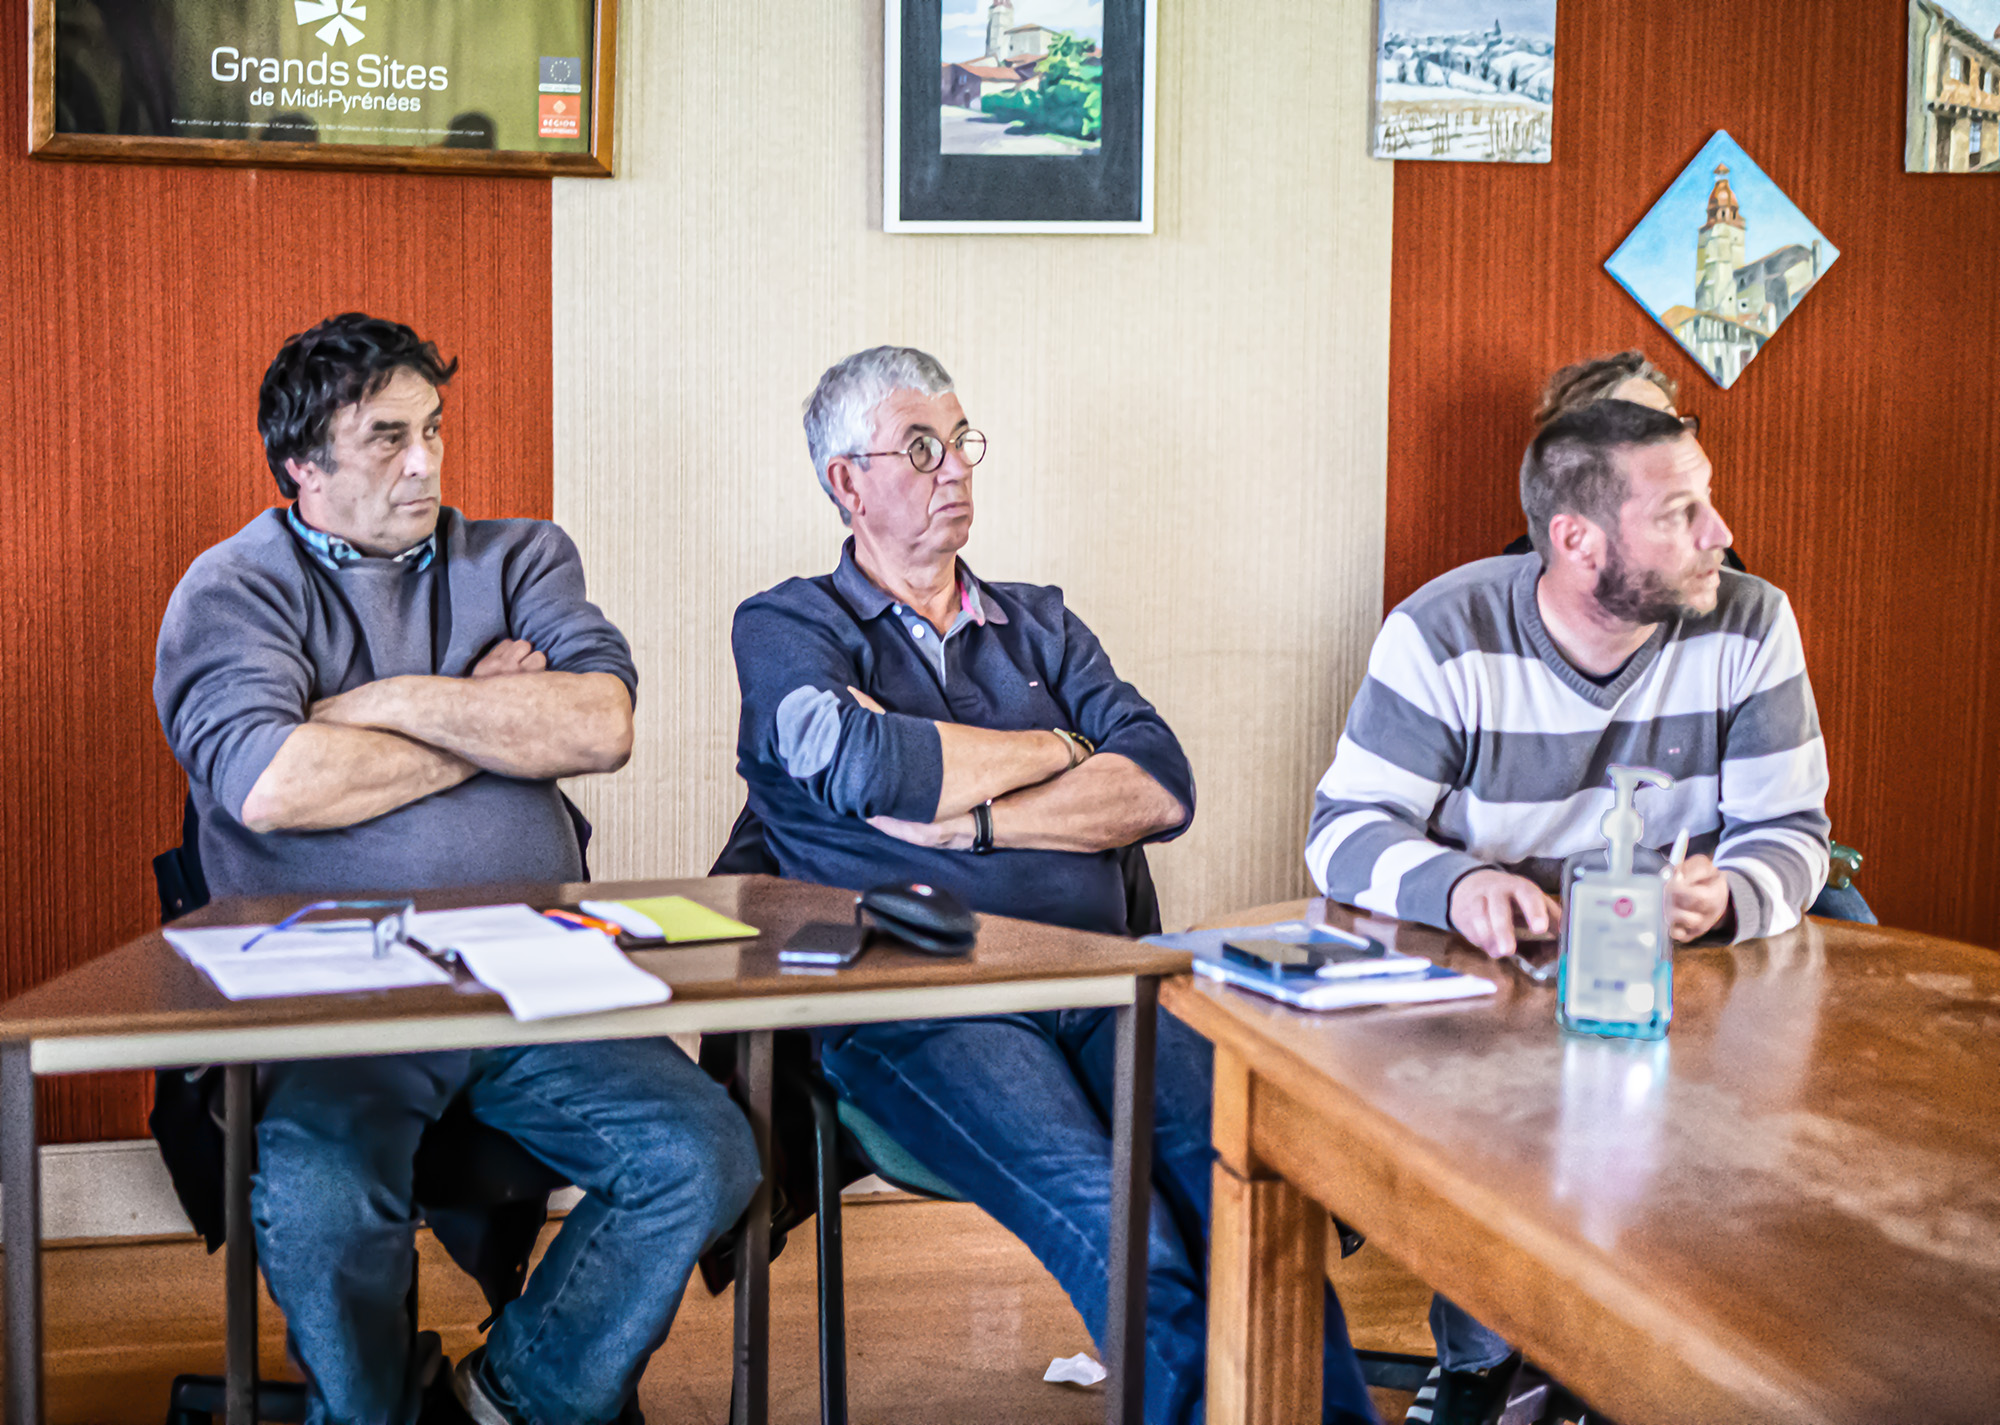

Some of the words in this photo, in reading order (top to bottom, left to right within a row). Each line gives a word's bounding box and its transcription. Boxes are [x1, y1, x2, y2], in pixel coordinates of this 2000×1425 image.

[211, 46, 350, 86] Grands
[356, 53, 449, 92] Sites
[249, 87, 275, 107] de
[281, 87, 422, 115] Midi-Pyrénées
